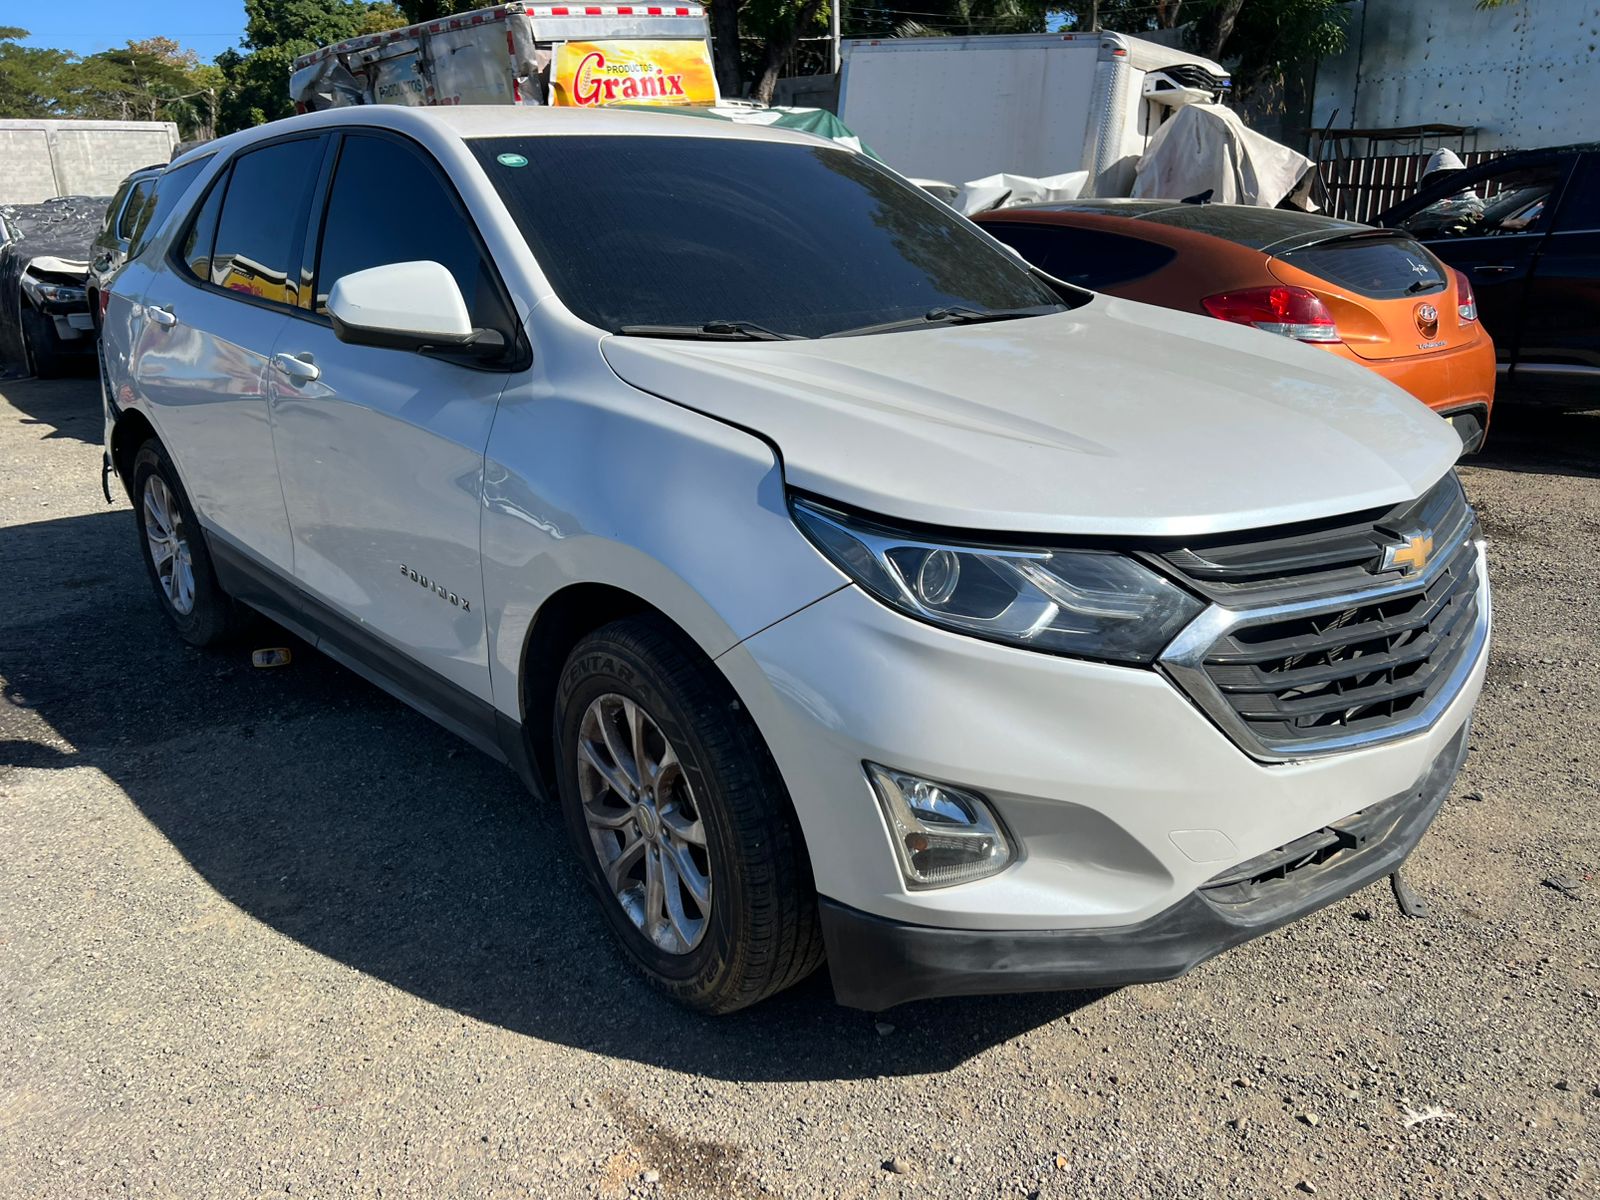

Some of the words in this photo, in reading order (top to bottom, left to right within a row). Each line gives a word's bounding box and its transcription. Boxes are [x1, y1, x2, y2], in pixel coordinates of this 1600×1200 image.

[574, 52, 684, 105] Granix
[606, 63, 653, 74] PRODUCTOS
[399, 563, 471, 613] EQUINOX
